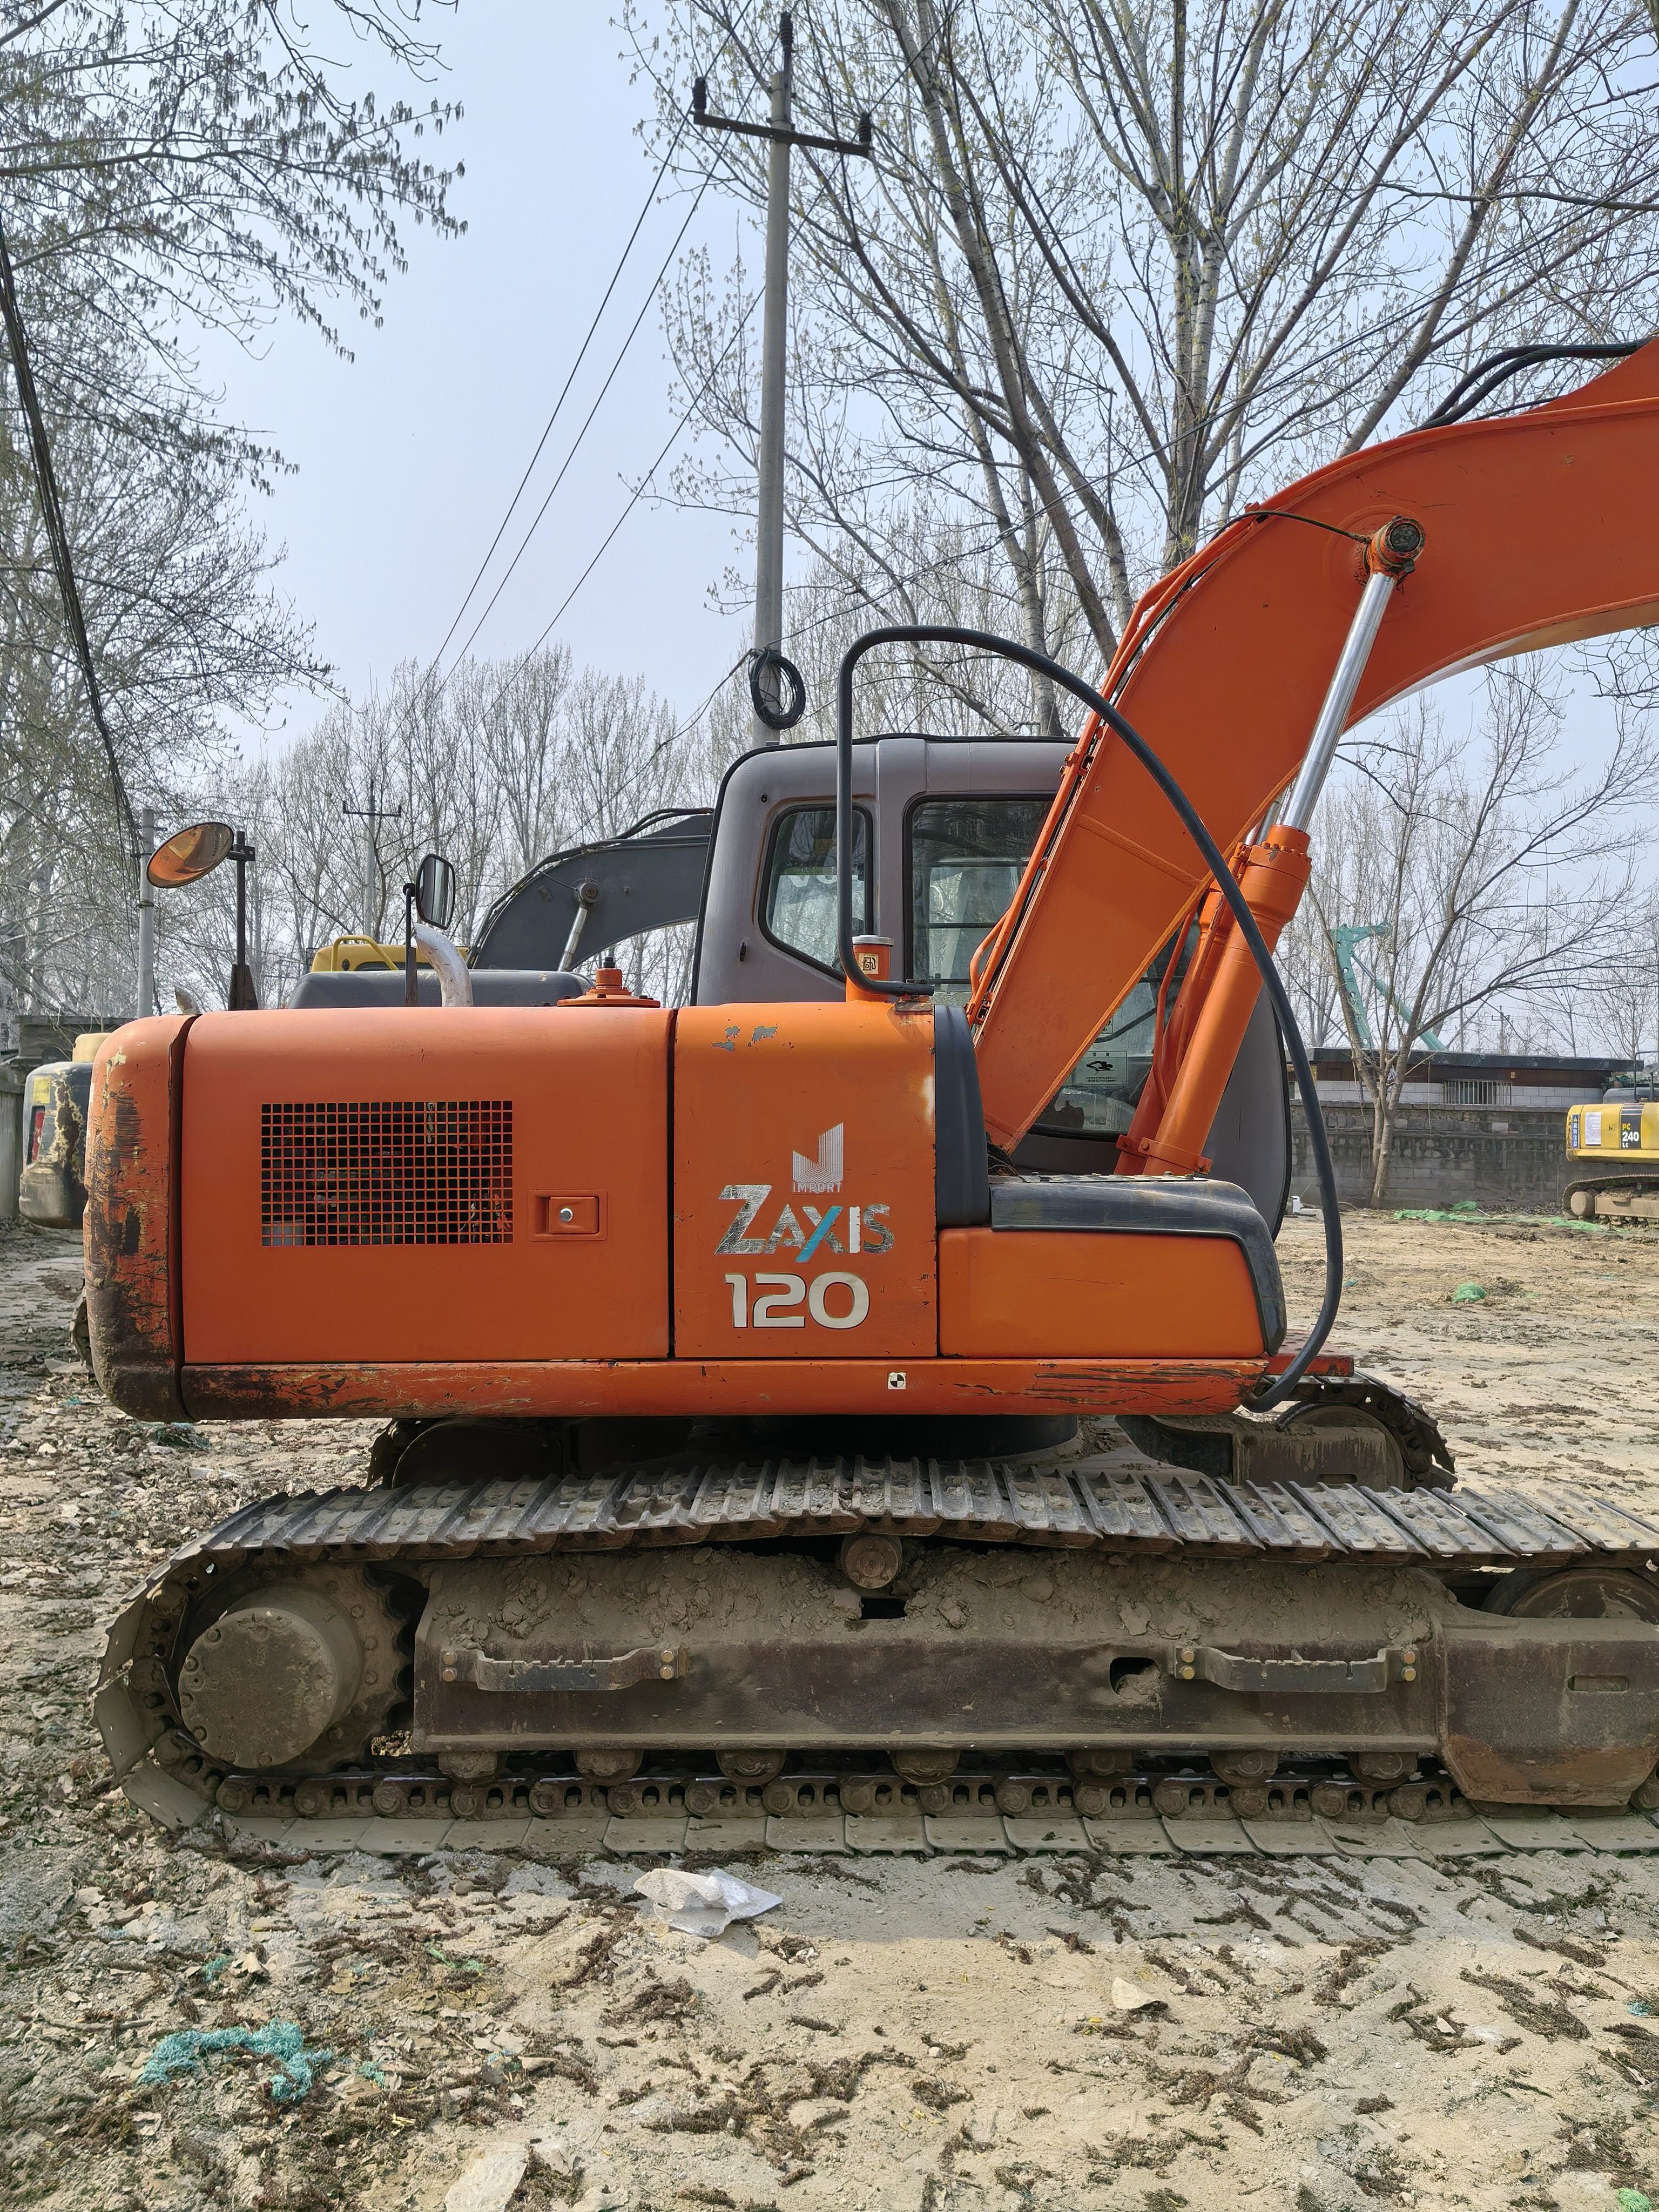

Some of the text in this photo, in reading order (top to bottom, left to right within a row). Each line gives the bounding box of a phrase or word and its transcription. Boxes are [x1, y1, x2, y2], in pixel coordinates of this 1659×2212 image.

[1622, 1131, 1640, 1142] 240
[792, 1182, 842, 1193] IMPORT
[713, 1184, 895, 1263] ZAXIS
[725, 1271, 871, 1330] 120
